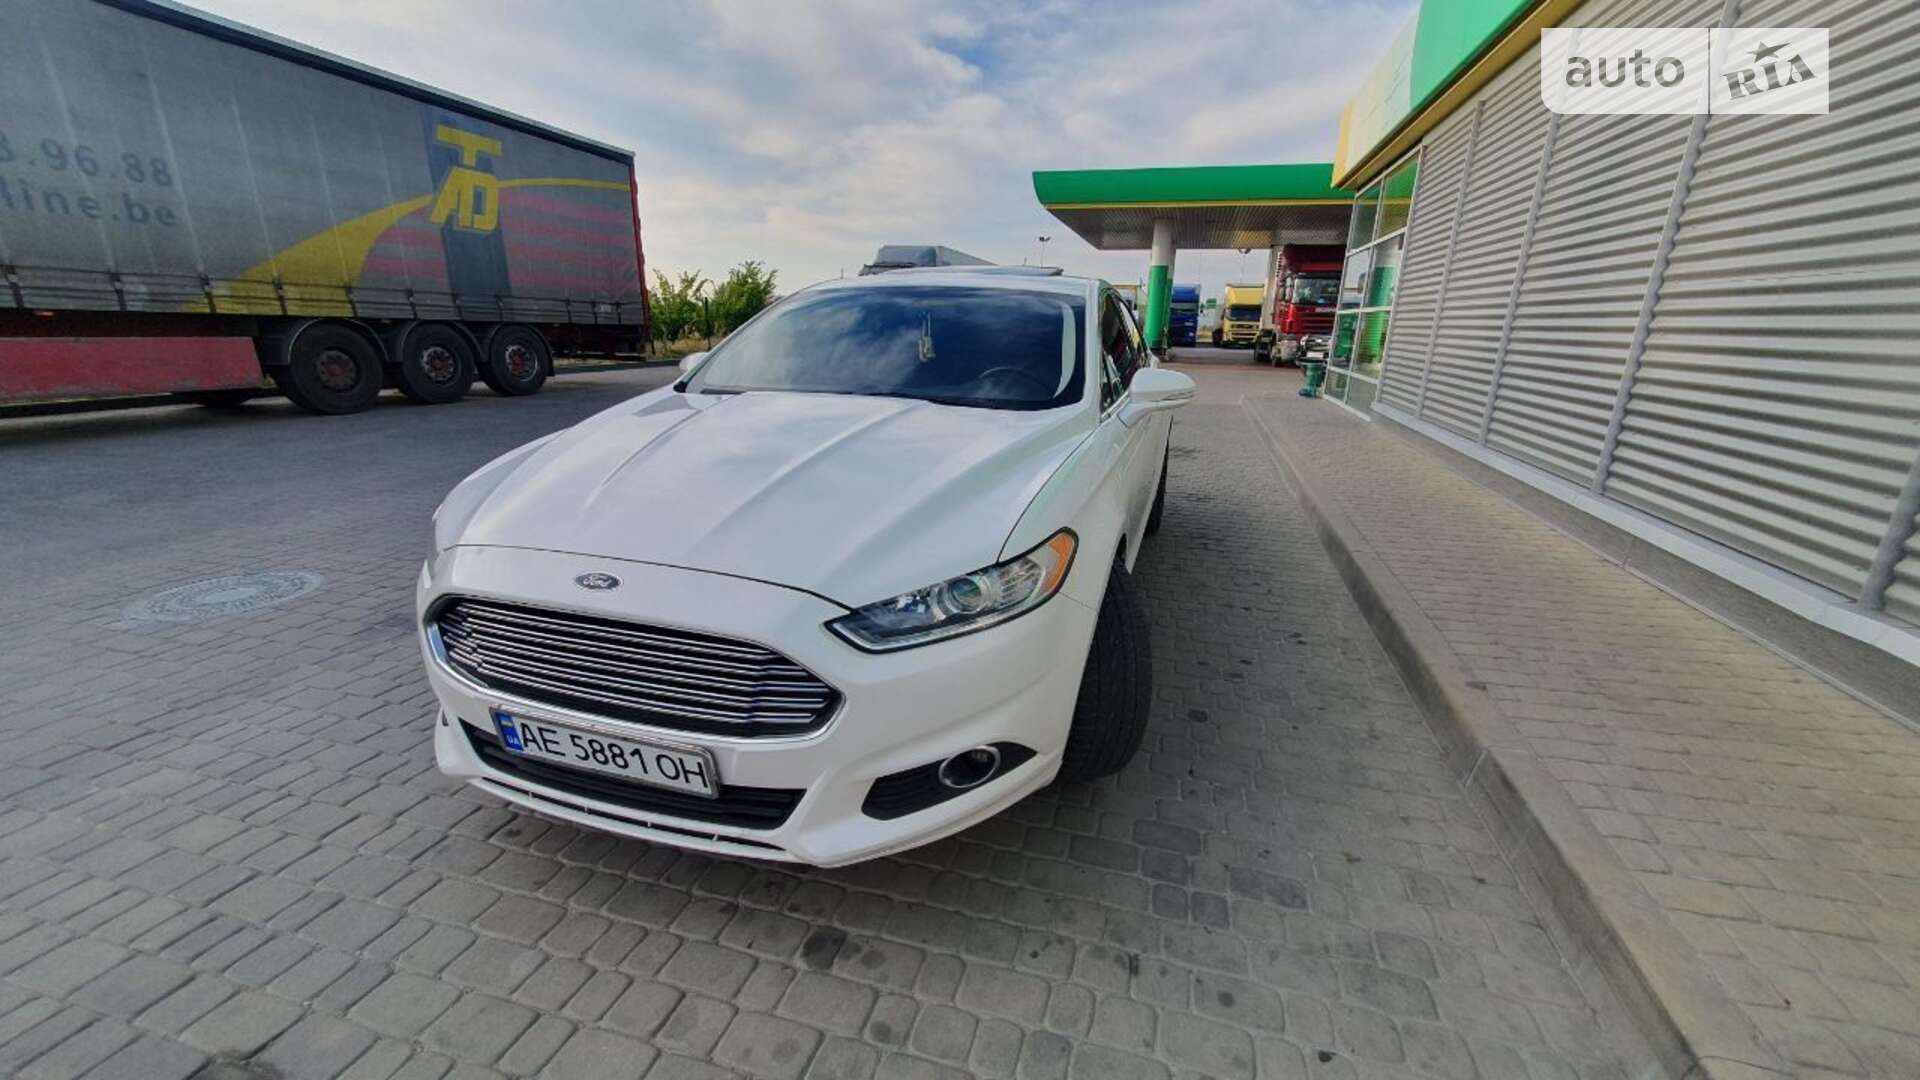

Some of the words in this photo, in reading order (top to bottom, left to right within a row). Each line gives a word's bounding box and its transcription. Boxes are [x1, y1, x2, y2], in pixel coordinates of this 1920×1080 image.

[520, 722, 565, 757] AE
[569, 734, 648, 774] 5881
[655, 753, 709, 788] OH
